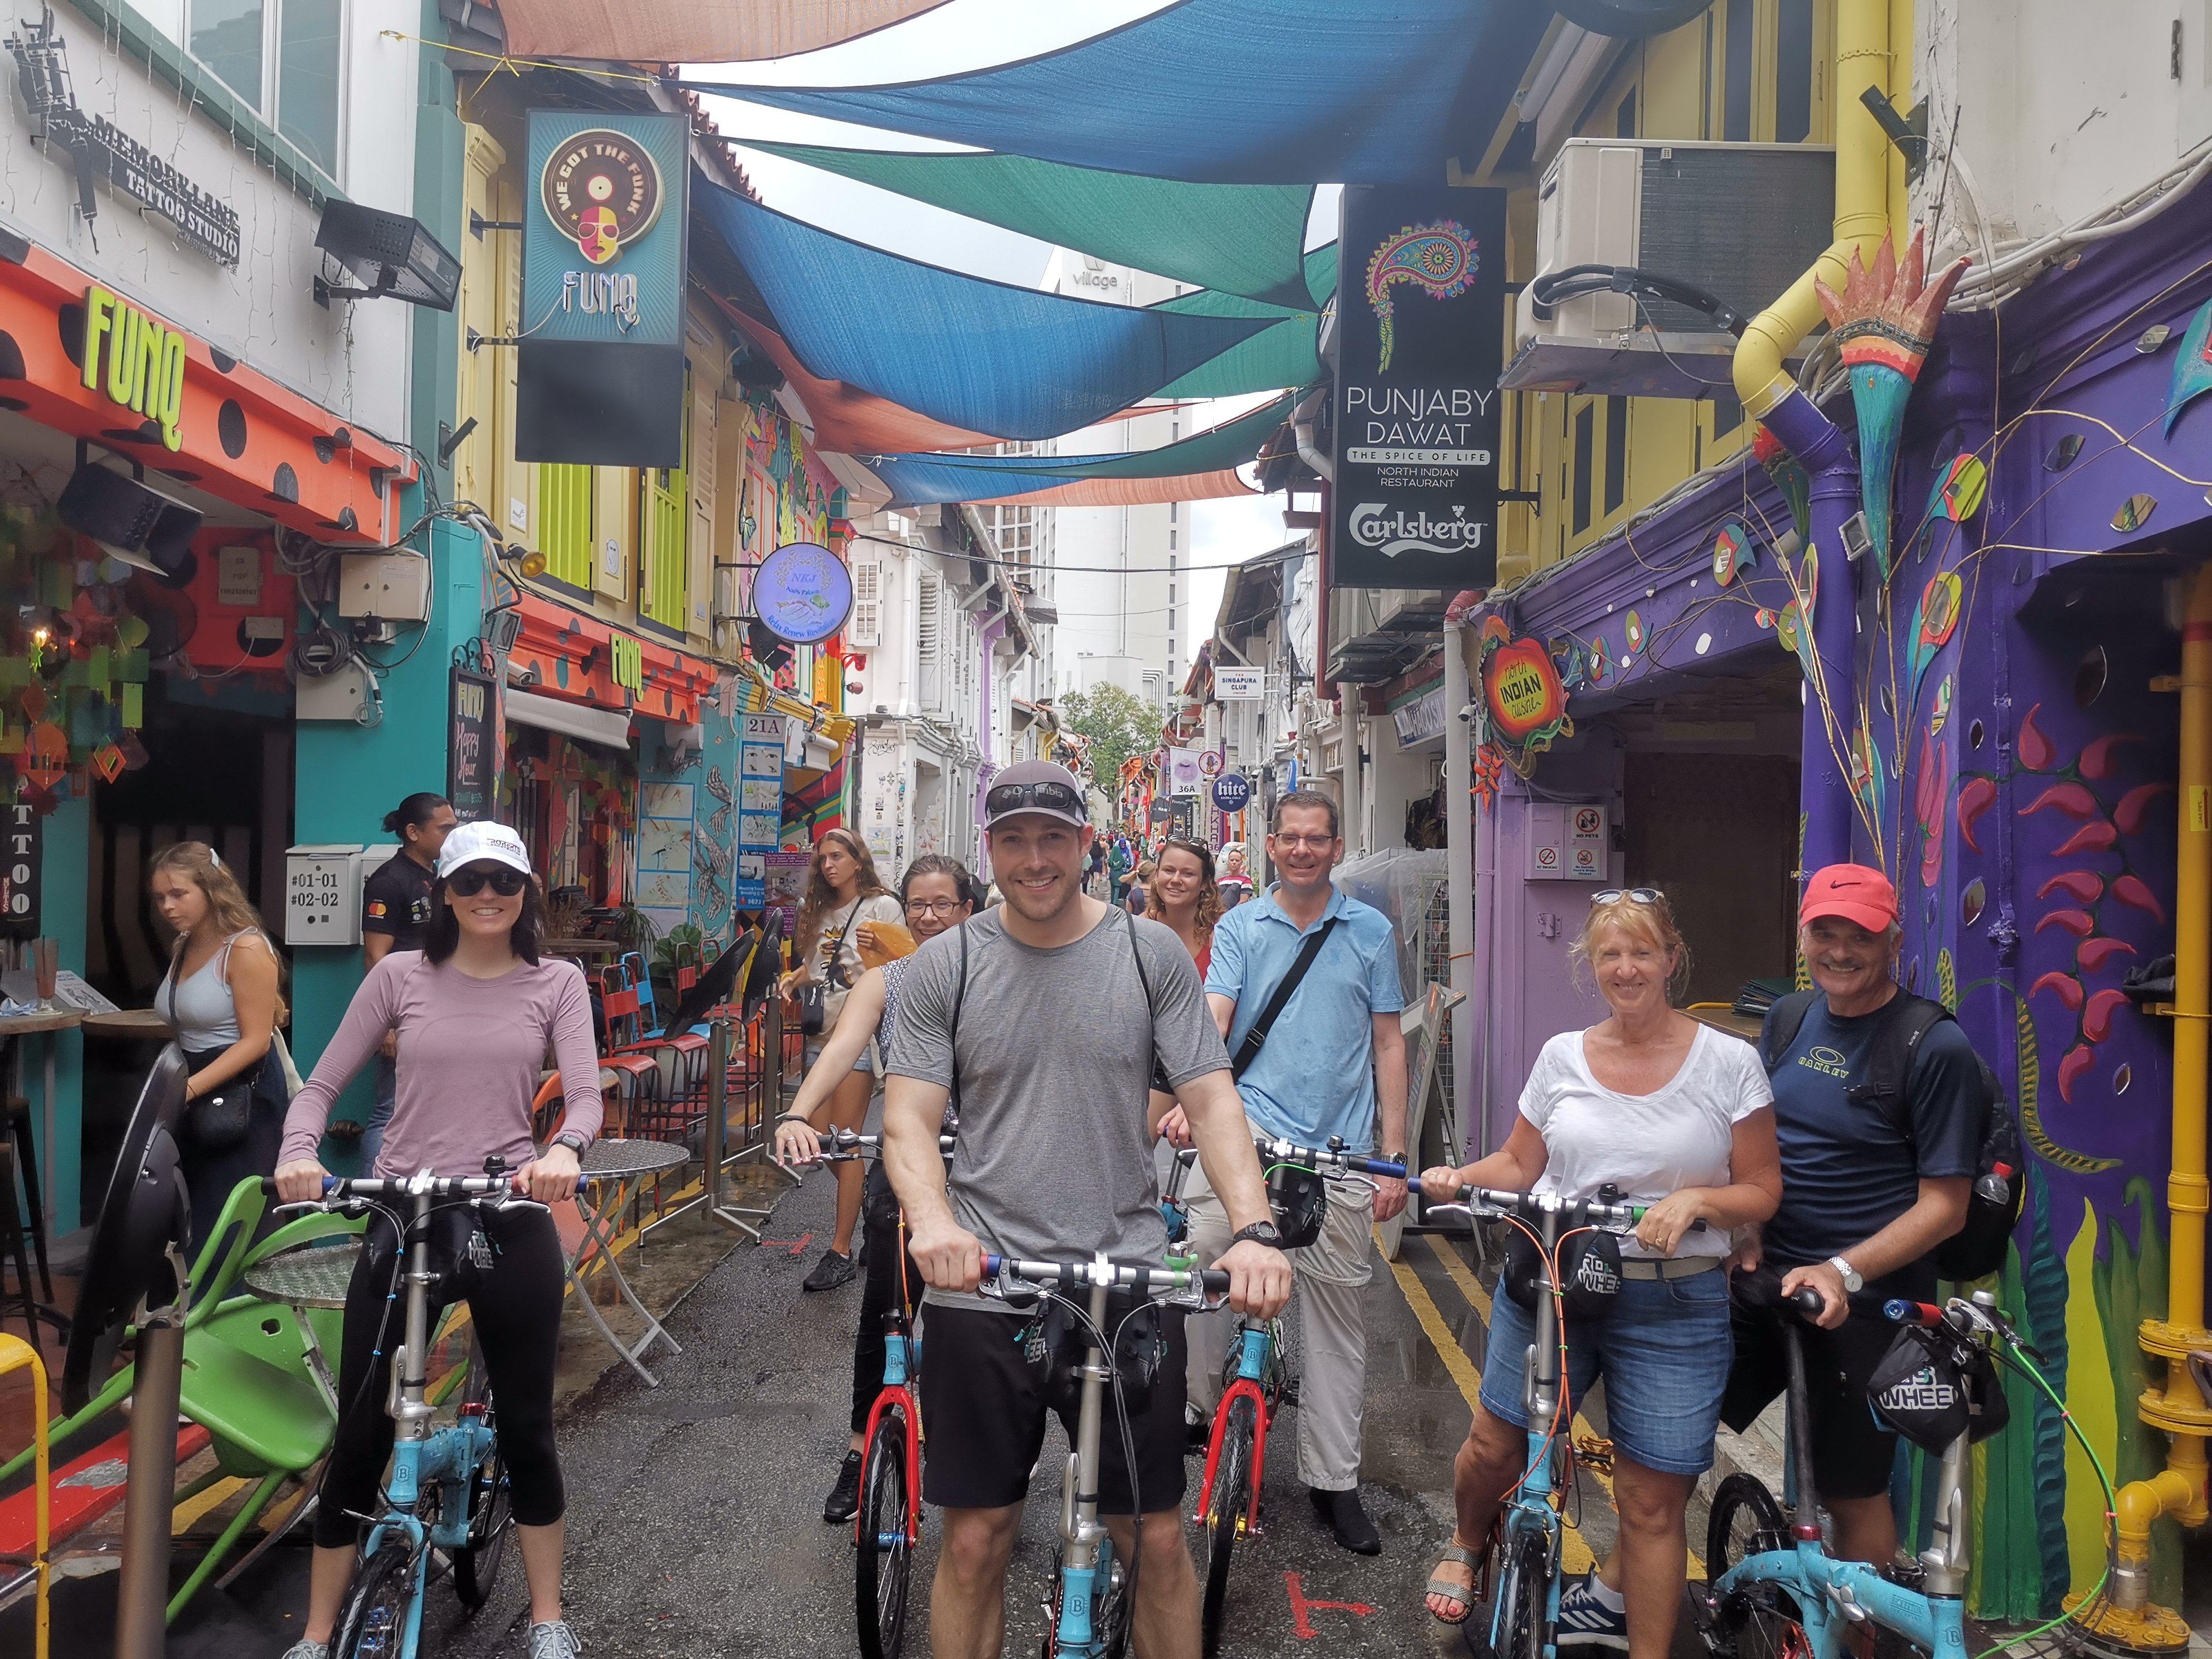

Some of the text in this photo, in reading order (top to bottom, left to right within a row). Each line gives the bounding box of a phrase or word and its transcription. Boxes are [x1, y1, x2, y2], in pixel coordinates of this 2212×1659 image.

[556, 143, 644, 216] WE GOT THE FUNK
[127, 168, 186, 223] TATTOO
[188, 212, 238, 258] STUDIO
[1073, 271, 1117, 290] village
[563, 271, 639, 327] FUNQ
[83, 285, 186, 453] FUNQ
[1347, 386, 1493, 421] PUNJABY
[1367, 423, 1472, 446] DAWAT
[1352, 451, 1486, 462] THE SPICE OF LIFE
[1377, 467, 1459, 477] NORTH INDIAN
[1380, 478, 1456, 488] RESTAURANT
[1349, 503, 1483, 549] Carlsberg
[767, 614, 783, 631] Relax
[783, 625, 805, 638] Renew
[609, 633, 644, 702] FUNQ
[1505, 657, 1527, 681] north
[1500, 673, 1542, 704] INDIAN
[749, 719, 780, 734] 21A
[455, 721, 479, 758] Happy
[1178, 785, 1196, 793] 36A
[1217, 781, 1246, 796] hite
[12, 804, 33, 914] TTOO
[292, 874, 338, 887] #01-01
[291, 892, 338, 906] #02-02
[1798, 1056, 1850, 1079] OAKLEY
